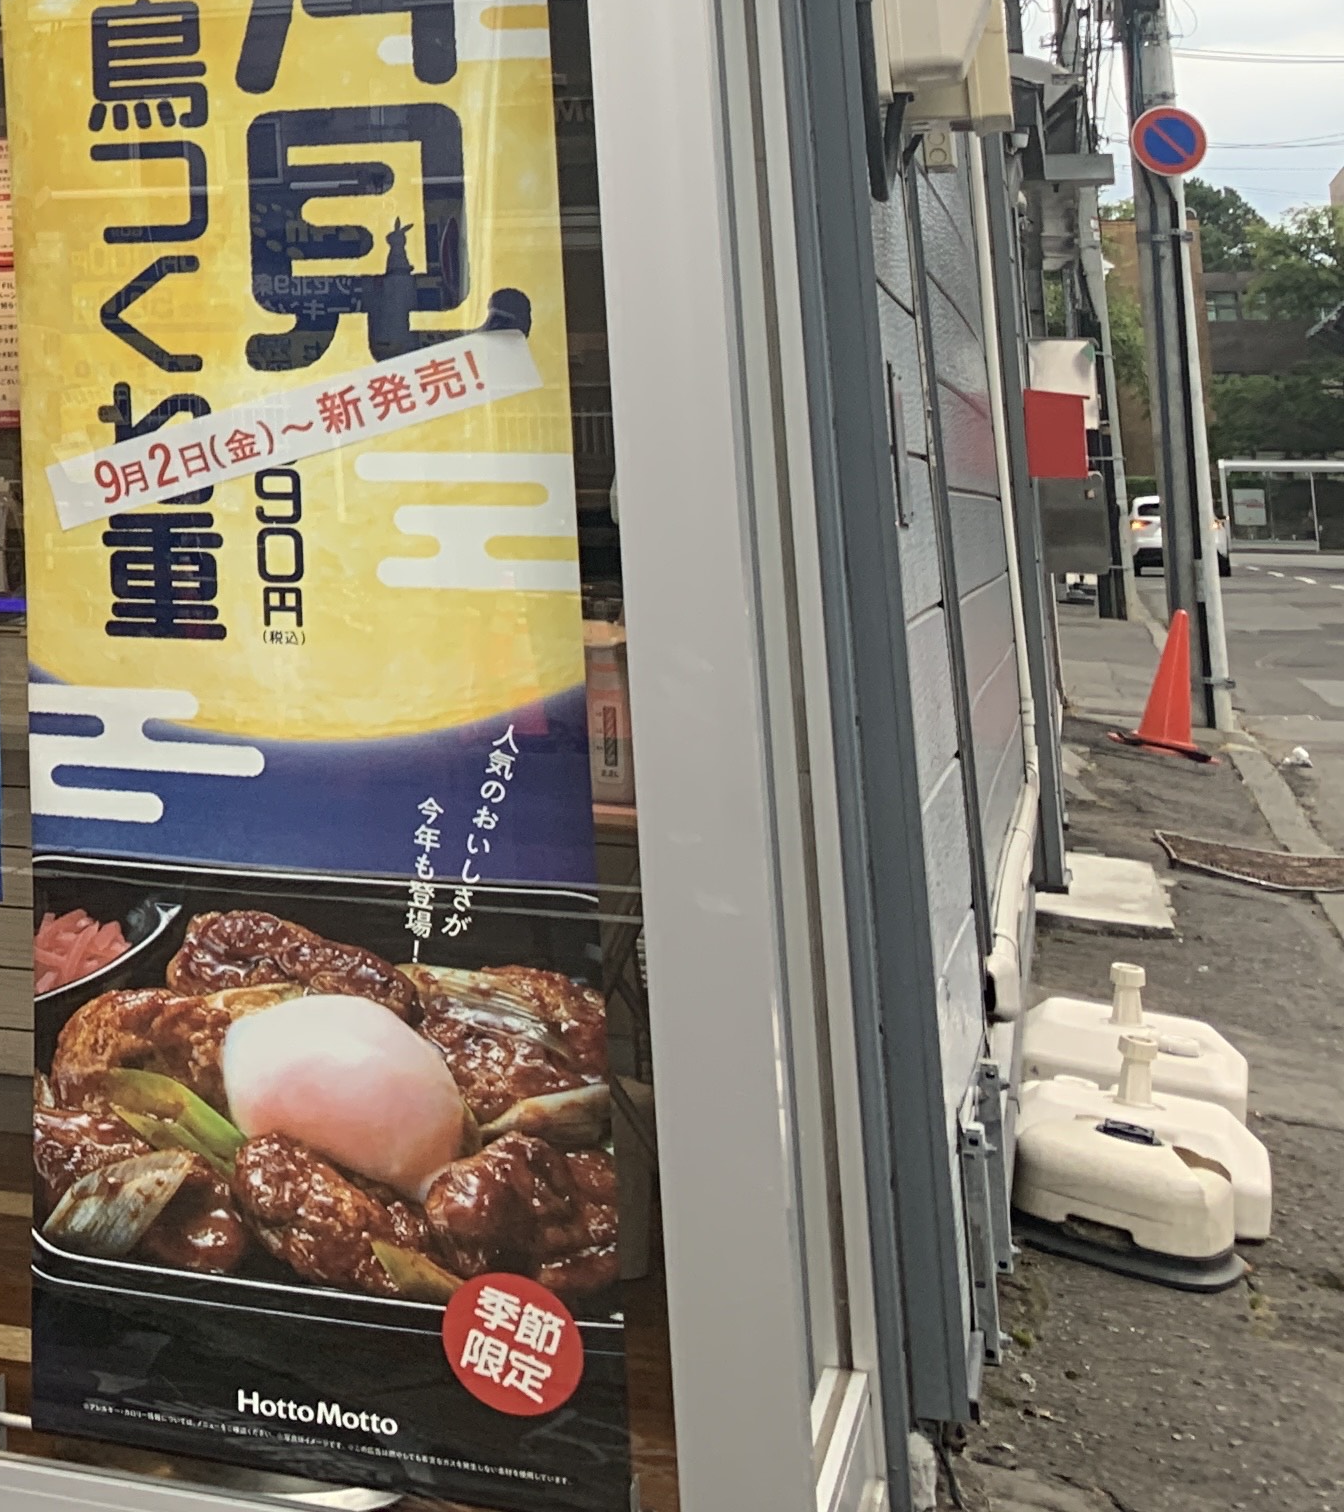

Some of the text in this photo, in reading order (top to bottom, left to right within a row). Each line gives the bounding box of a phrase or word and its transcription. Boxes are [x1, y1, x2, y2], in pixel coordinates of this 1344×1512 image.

[405, 797, 445, 964] 今年も登場!
[442, 724, 521, 938] 人気のおいしさが
[459, 1329, 554, 1405] 限定
[473, 1285, 565, 1358] 季節
